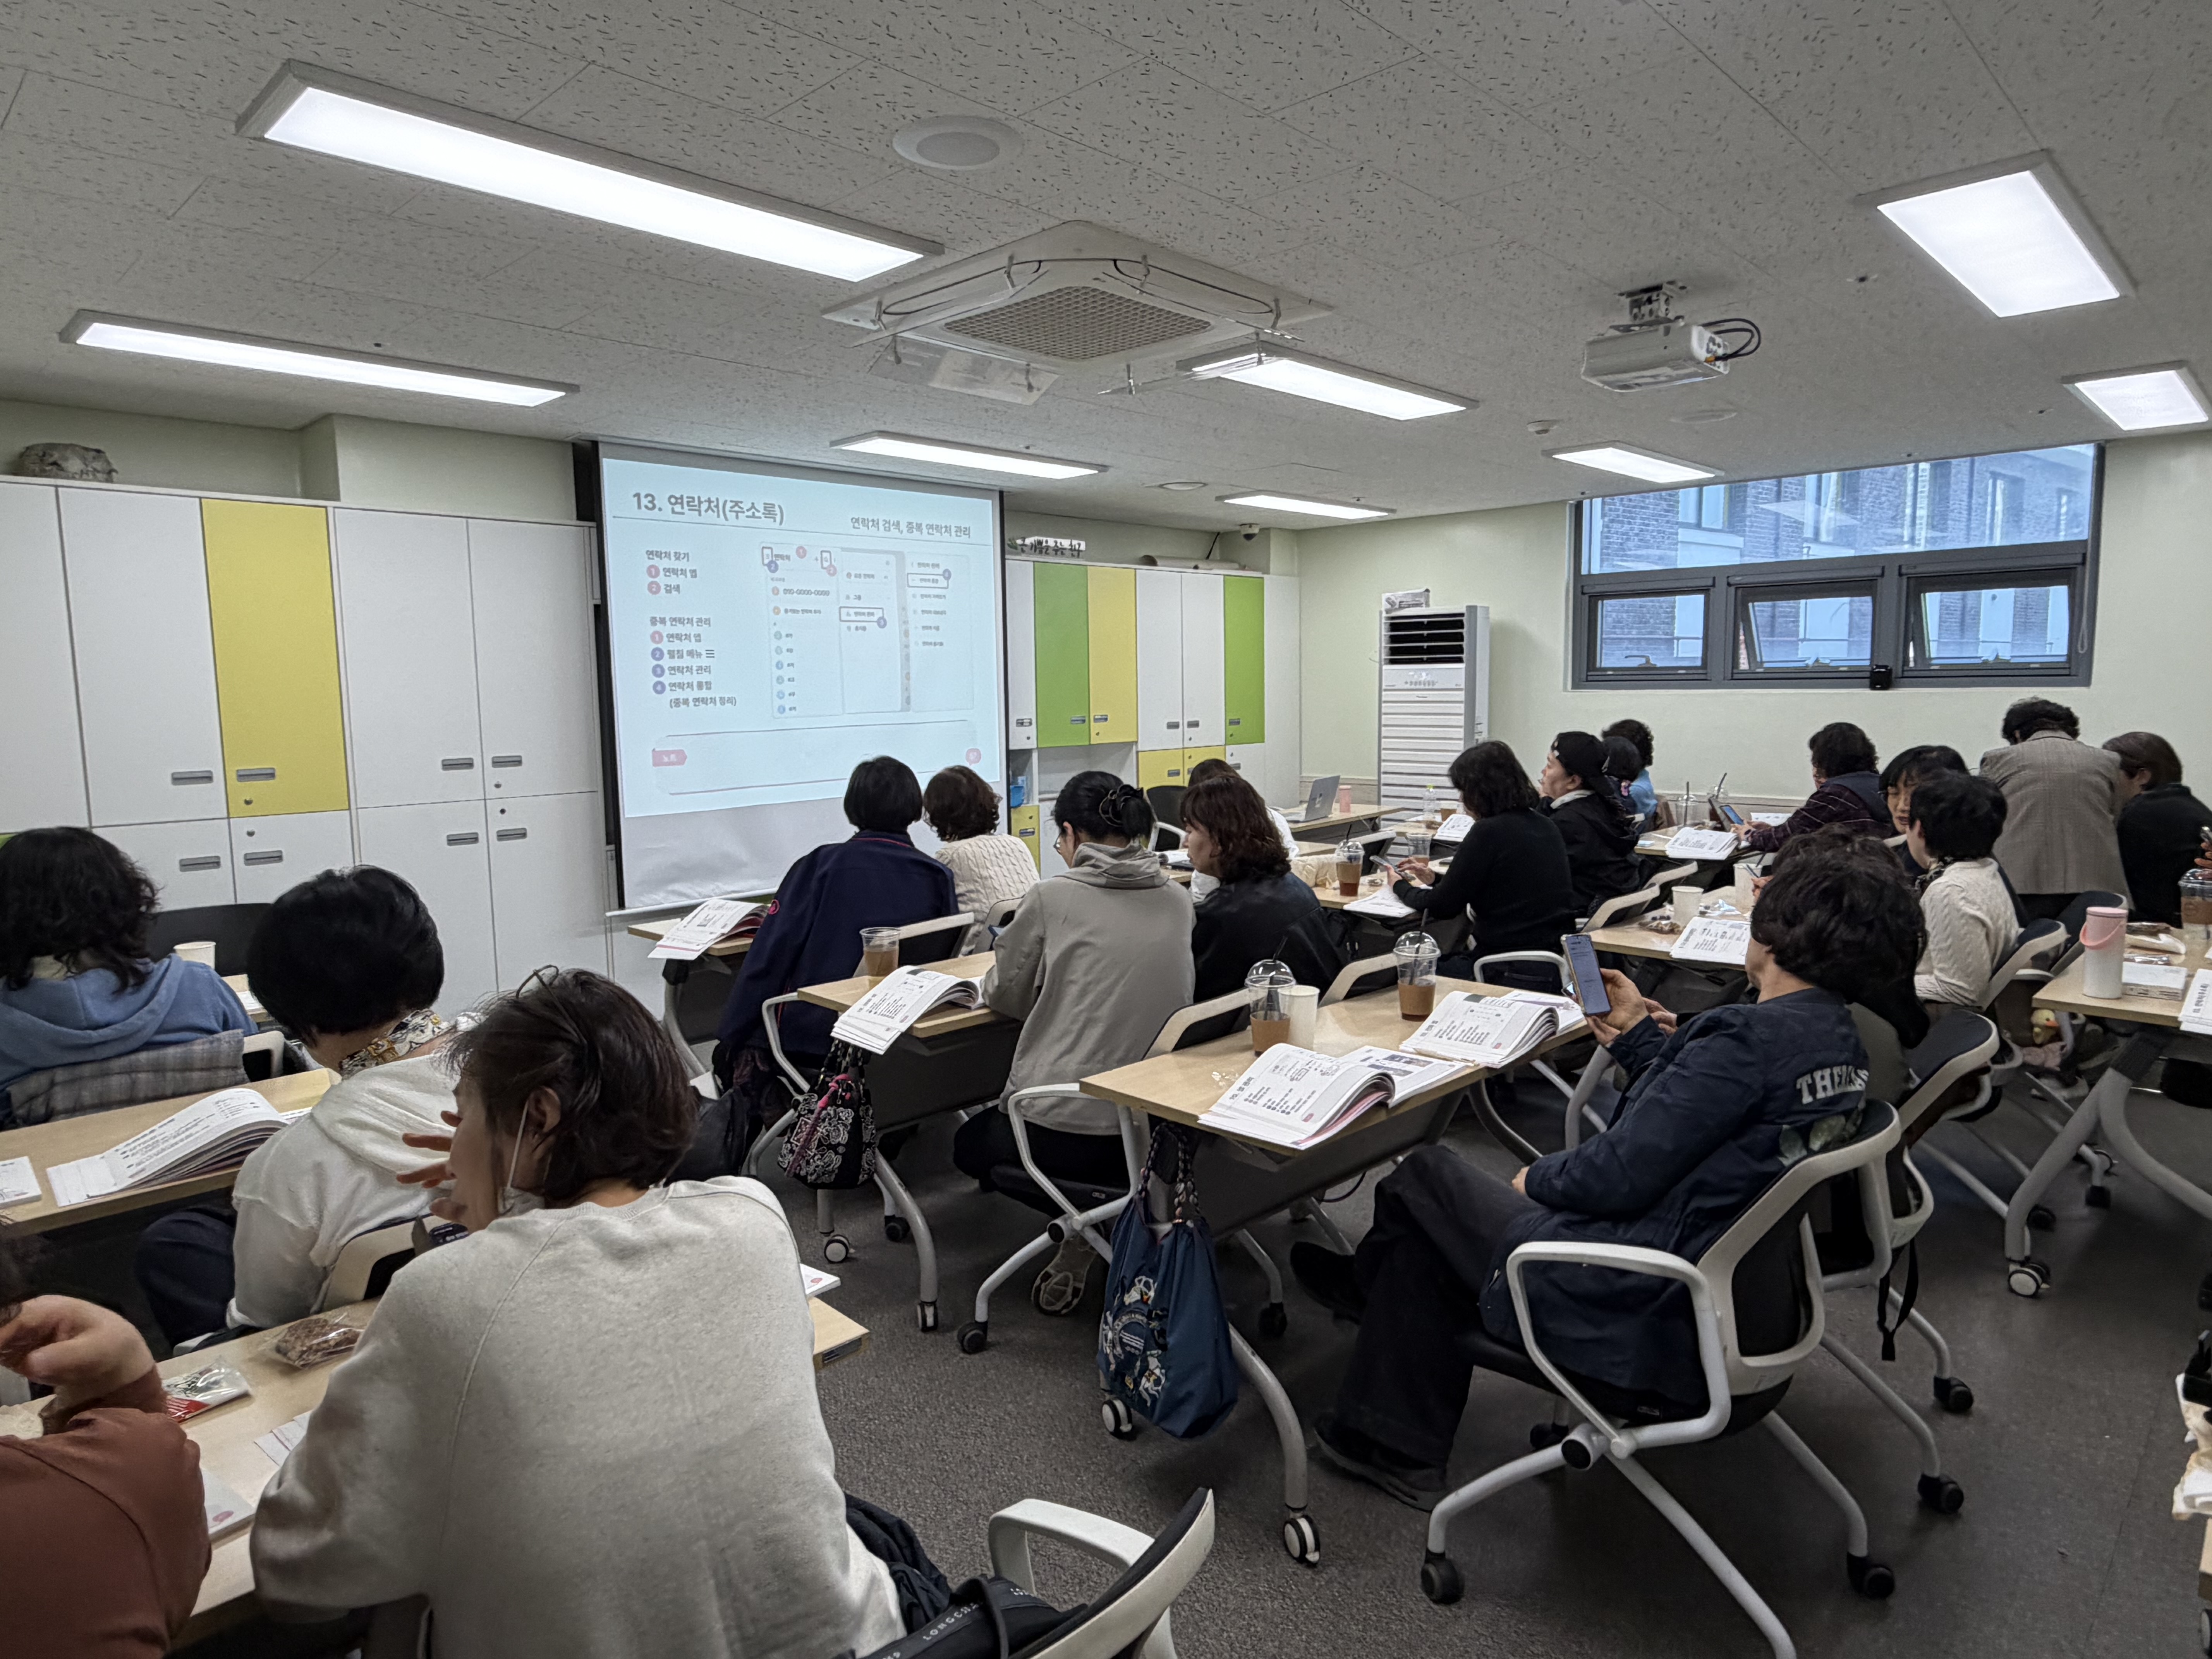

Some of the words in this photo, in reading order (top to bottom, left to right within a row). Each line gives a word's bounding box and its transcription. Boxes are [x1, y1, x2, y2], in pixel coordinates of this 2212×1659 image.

[633, 492, 663, 512] 13.
[667, 494, 784, 526] 연락처(주소록)
[851, 517, 879, 531] 연락처
[882, 519, 903, 534] 검색,
[906, 521, 923, 535] 중복
[925, 523, 952, 537] 연락처
[954, 526, 971, 538] 관리
[646, 550, 672, 562] 연락처
[663, 567, 687, 578] 연락처
[664, 584, 681, 594] 검색
[669, 617, 694, 627] 연락처
[696, 617, 711, 627] 관리
[666, 633, 692, 642] 연락처
[667, 665, 693, 675] 연락처
[696, 665, 711, 675] 관리
[668, 681, 694, 691] 연락처
[692, 697, 717, 707] 연락처
